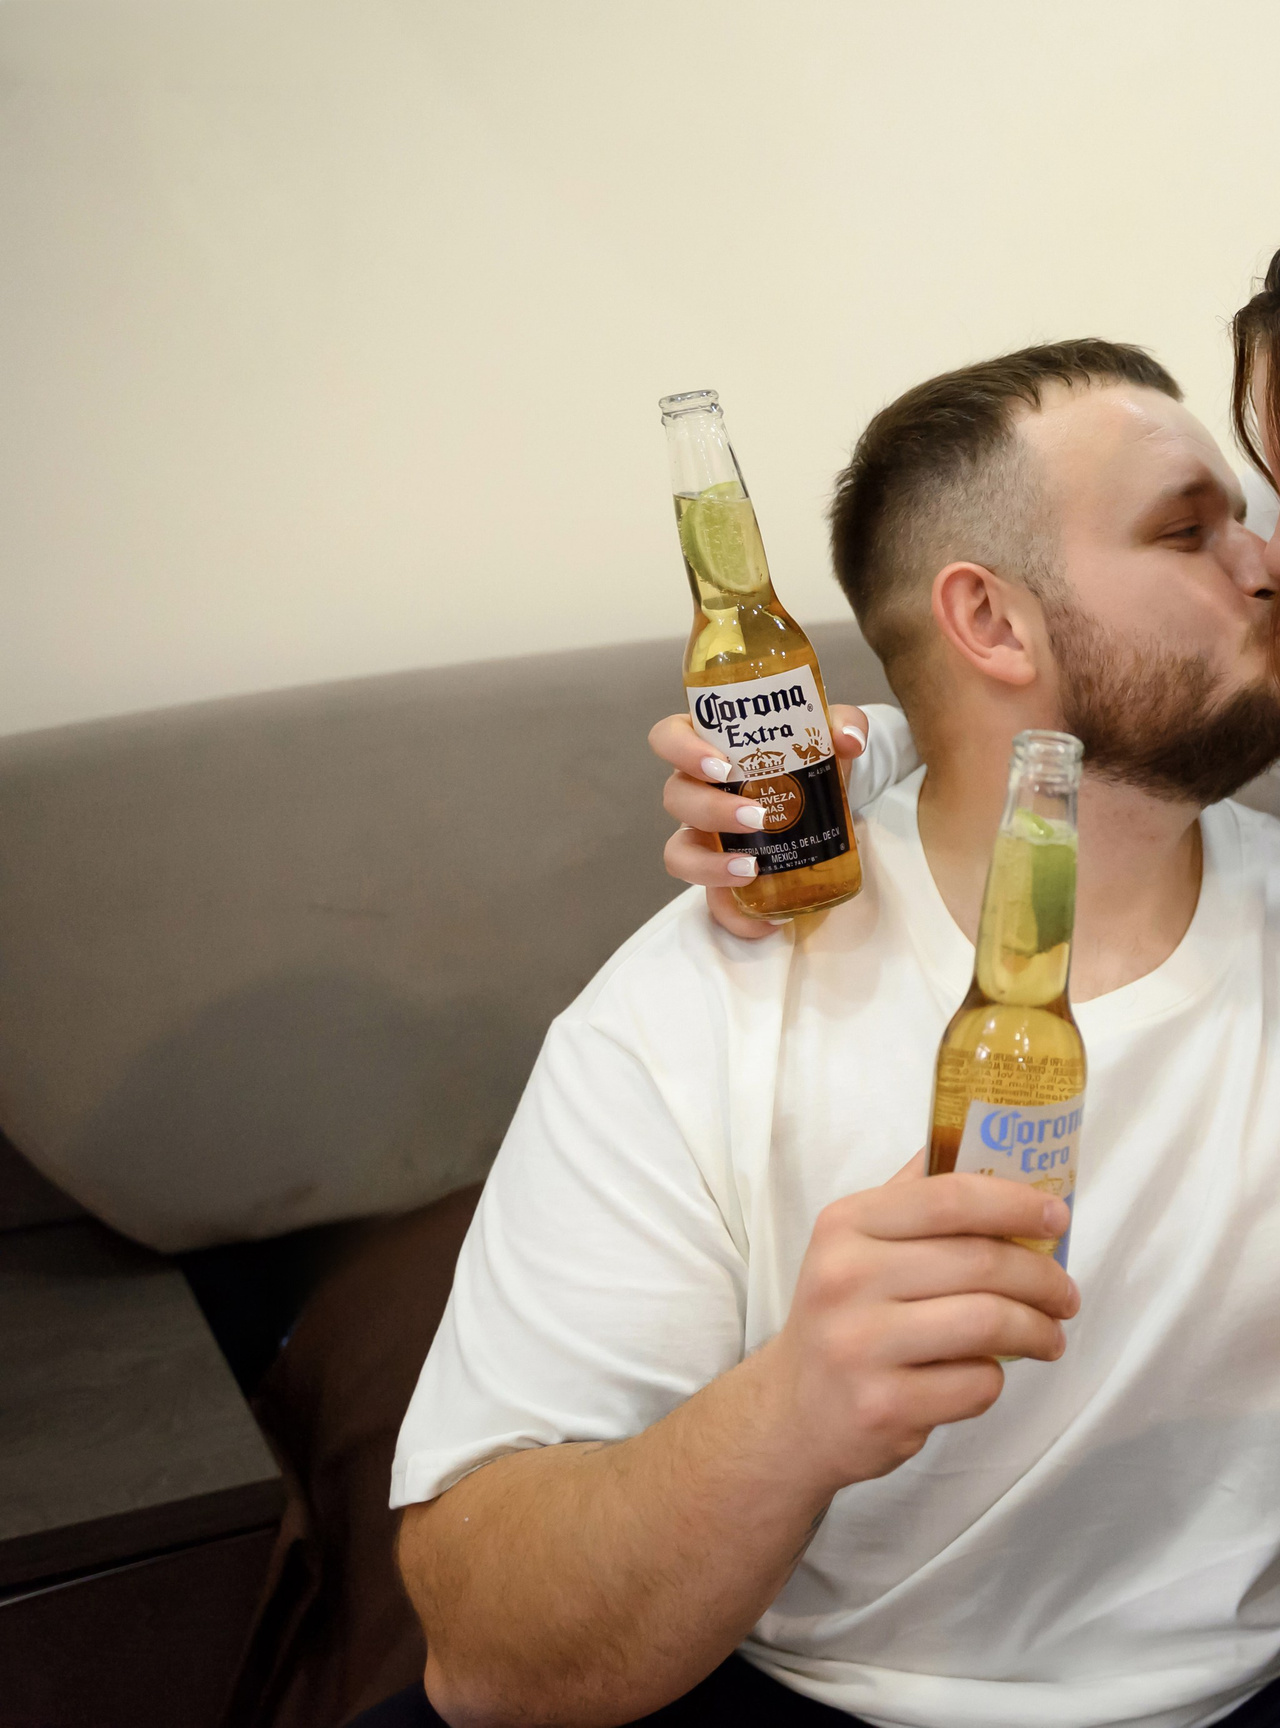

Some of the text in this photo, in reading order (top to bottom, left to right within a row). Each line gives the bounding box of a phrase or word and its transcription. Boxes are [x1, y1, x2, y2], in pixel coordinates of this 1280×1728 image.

[695, 685, 807, 733] Corona
[725, 723, 795, 748] Extra
[755, 791, 796, 805] RVEZA
[760, 786, 776, 796] LA
[799, 837, 809, 848] DE
[822, 830, 832, 841] DE
[771, 850, 798, 863] MEXICO
[1020, 1146, 1070, 1174] Cero
